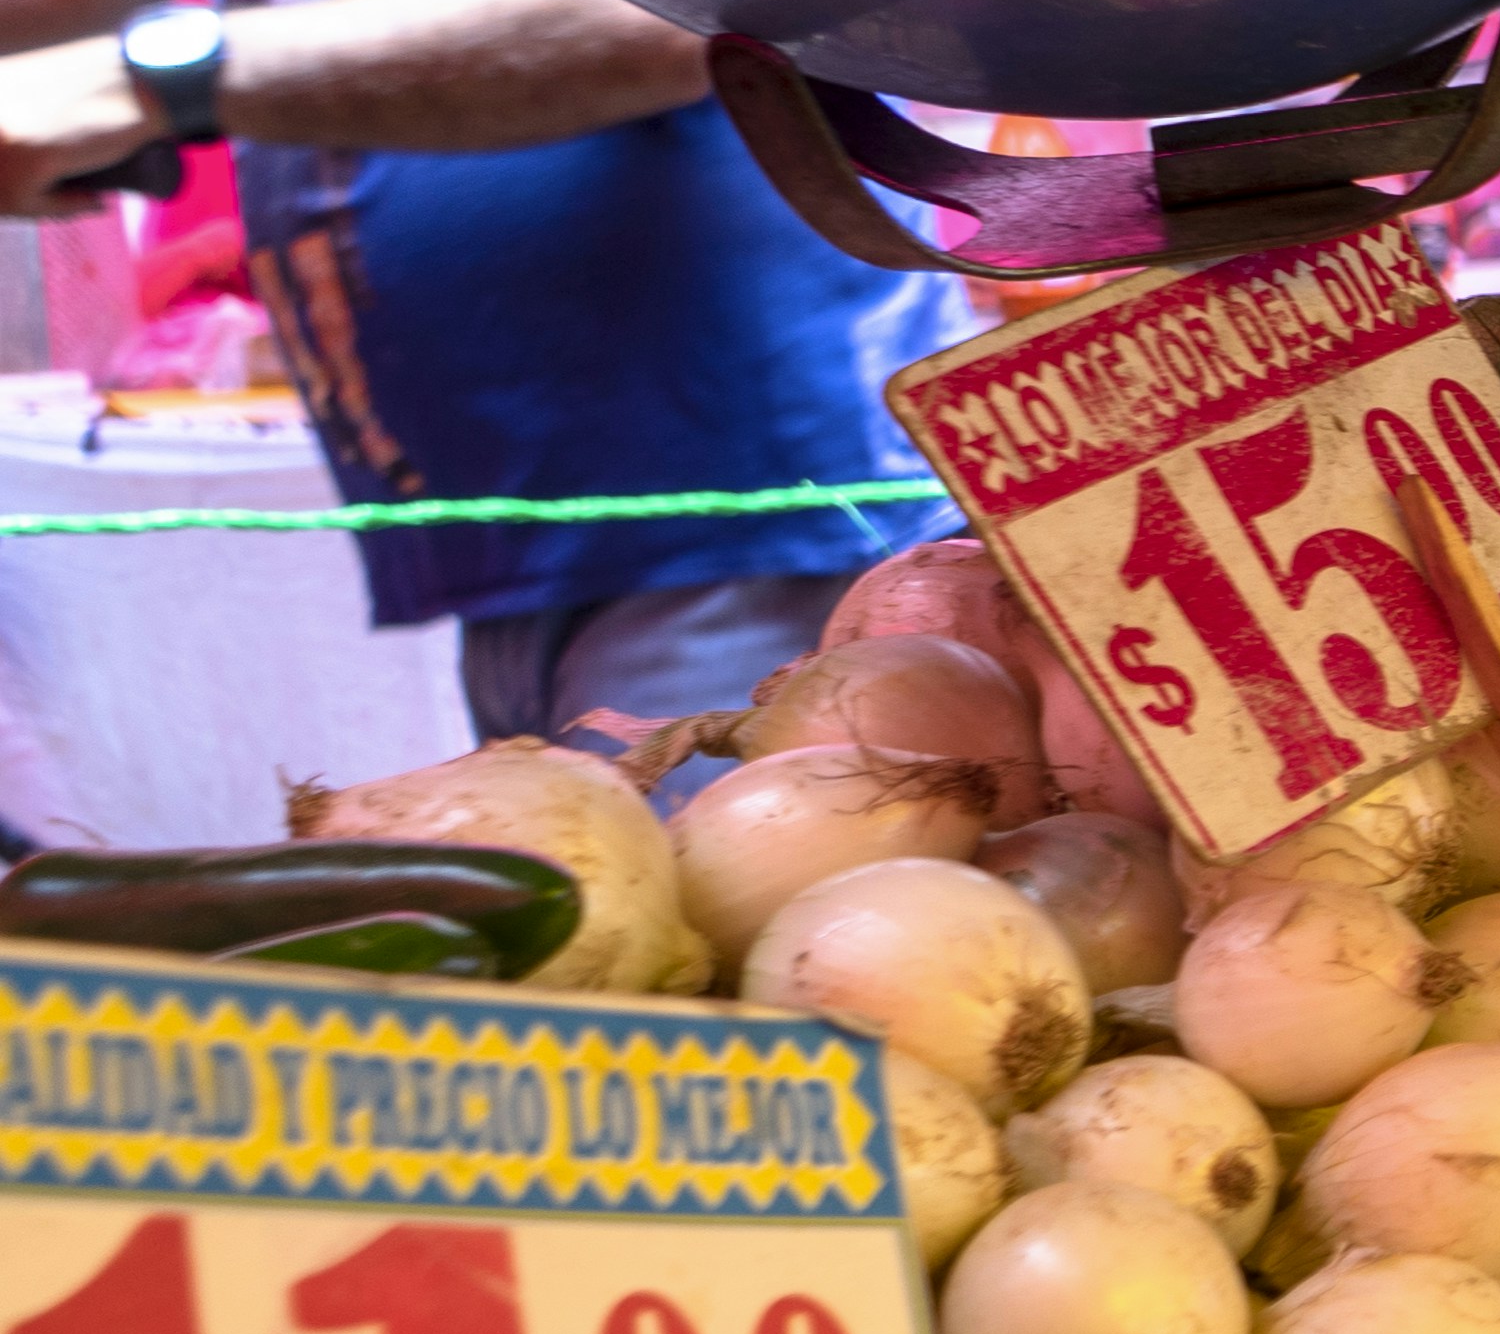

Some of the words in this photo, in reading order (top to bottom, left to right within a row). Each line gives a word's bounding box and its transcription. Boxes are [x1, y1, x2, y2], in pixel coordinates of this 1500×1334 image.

[996, 380, 1072, 470] LO
[1063, 308, 1238, 449] MEJOR
[1224, 266, 1332, 369] DEL
[1316, 239, 1405, 335] DIA
[1118, 404, 1463, 803] 15
[270, 1048, 307, 1145] Y
[330, 1054, 547, 1155] PRECIO
[564, 1068, 638, 1160] LO
[652, 1074, 847, 1166] MEJOR
